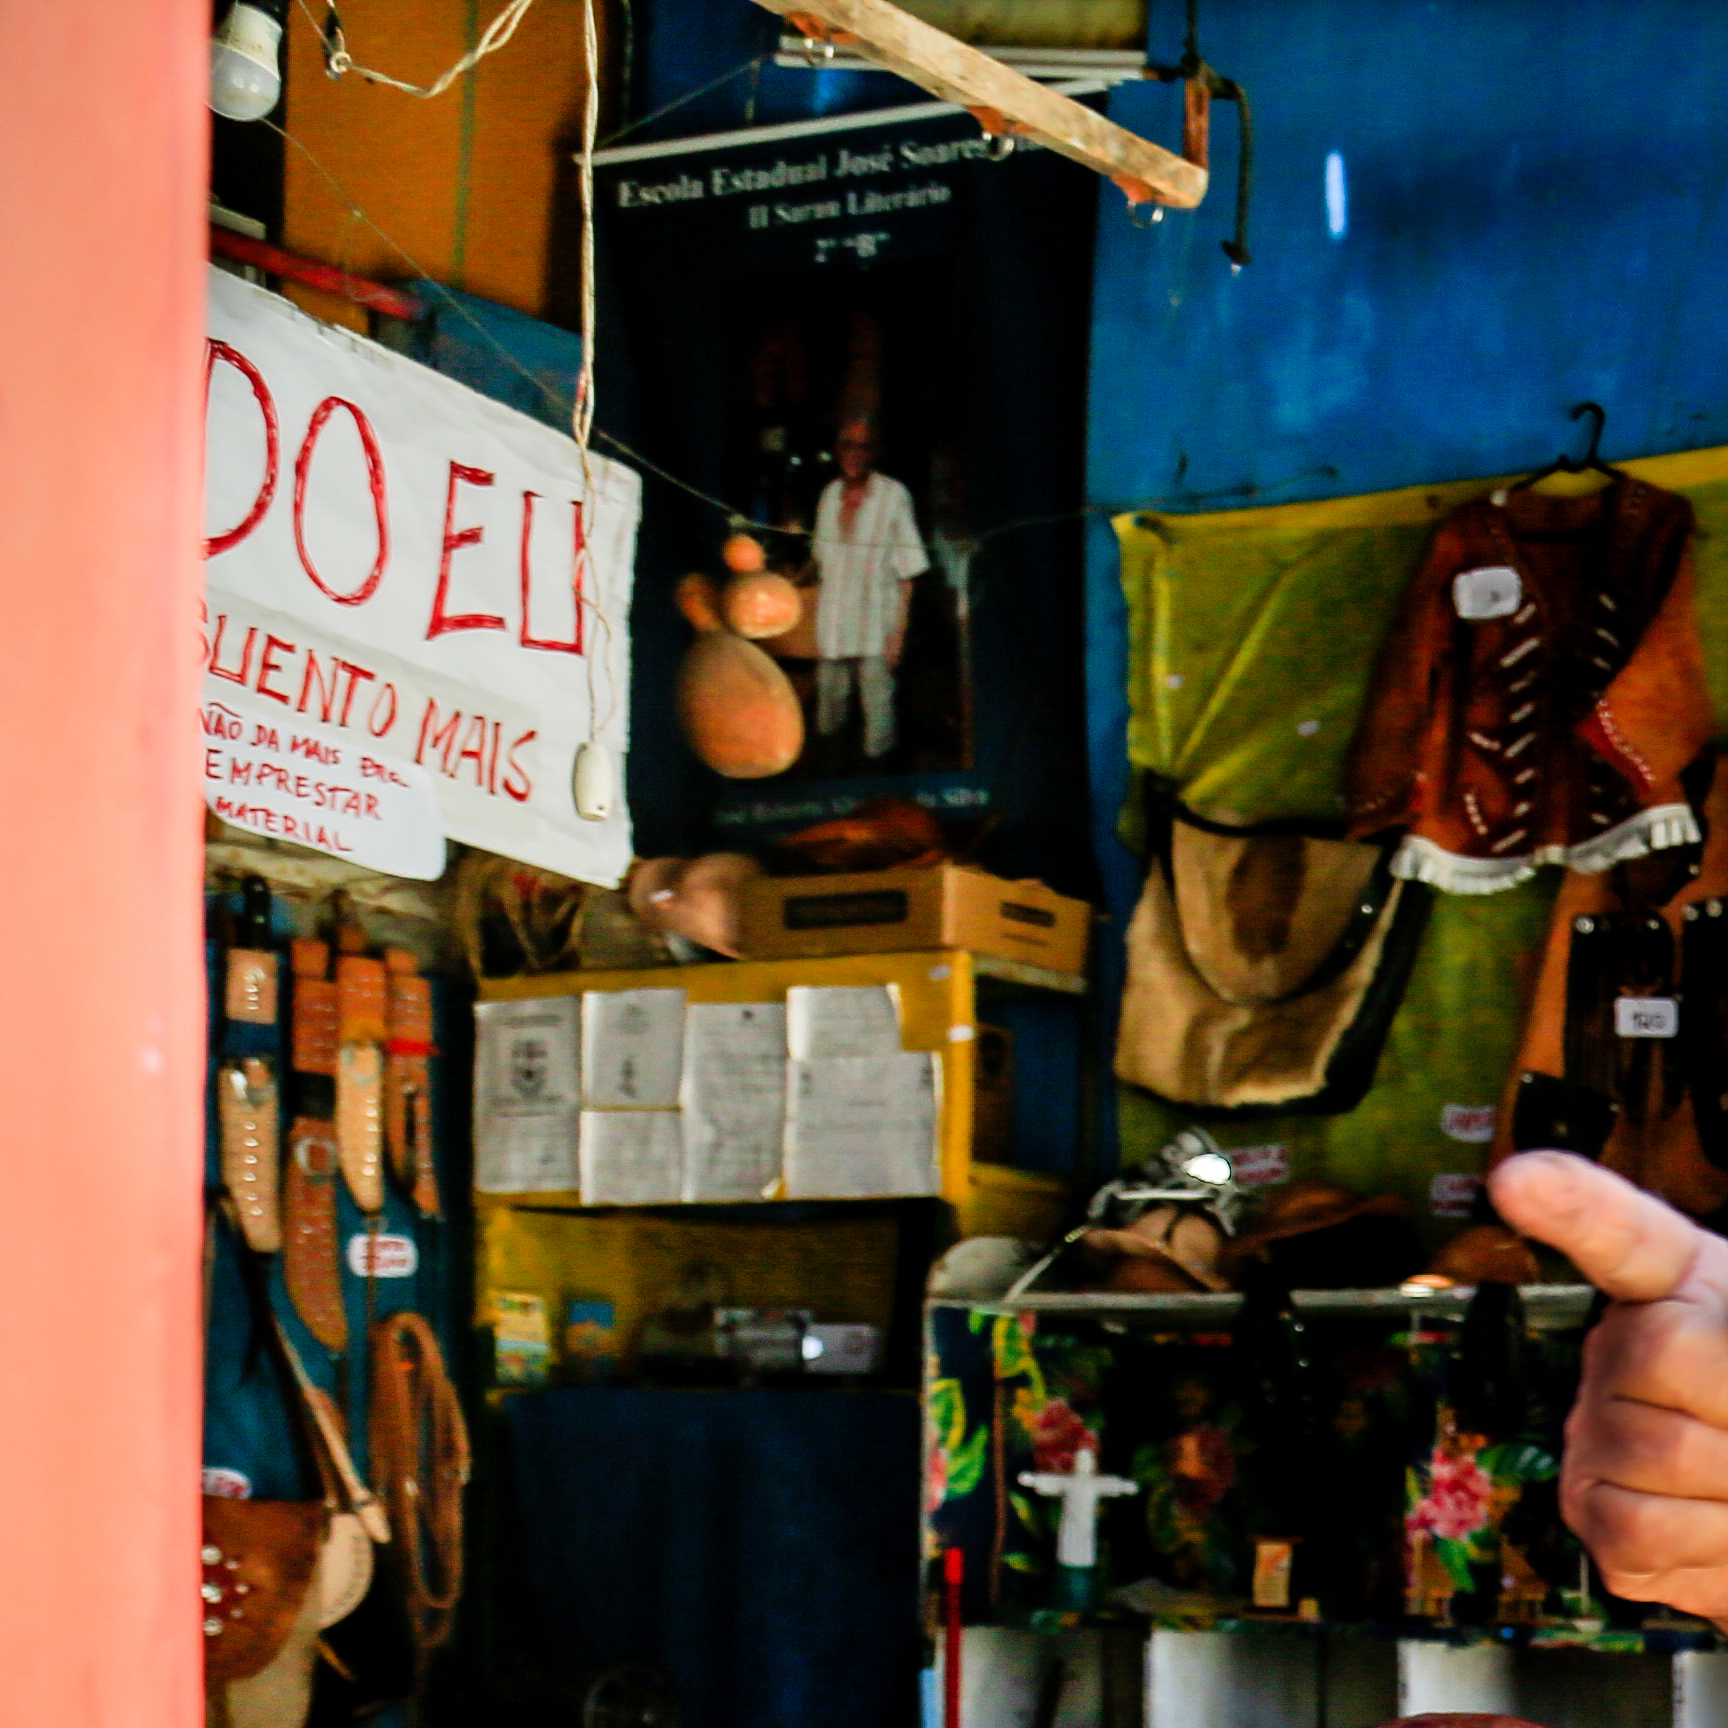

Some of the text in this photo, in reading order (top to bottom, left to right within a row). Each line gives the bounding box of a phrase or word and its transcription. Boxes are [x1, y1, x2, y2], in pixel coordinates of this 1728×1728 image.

[619, 173, 704, 207] Escola
[711, 155, 827, 195] Estadual
[834, 144, 894, 177] José
[426, 459, 584, 655] EU
[250, 724, 280, 752] DA
[289, 734, 344, 766] MAIS
[415, 696, 538, 803] MAIS
[204, 748, 384, 821] EMPRESTAR
[215, 795, 353, 852] MATERIAL
